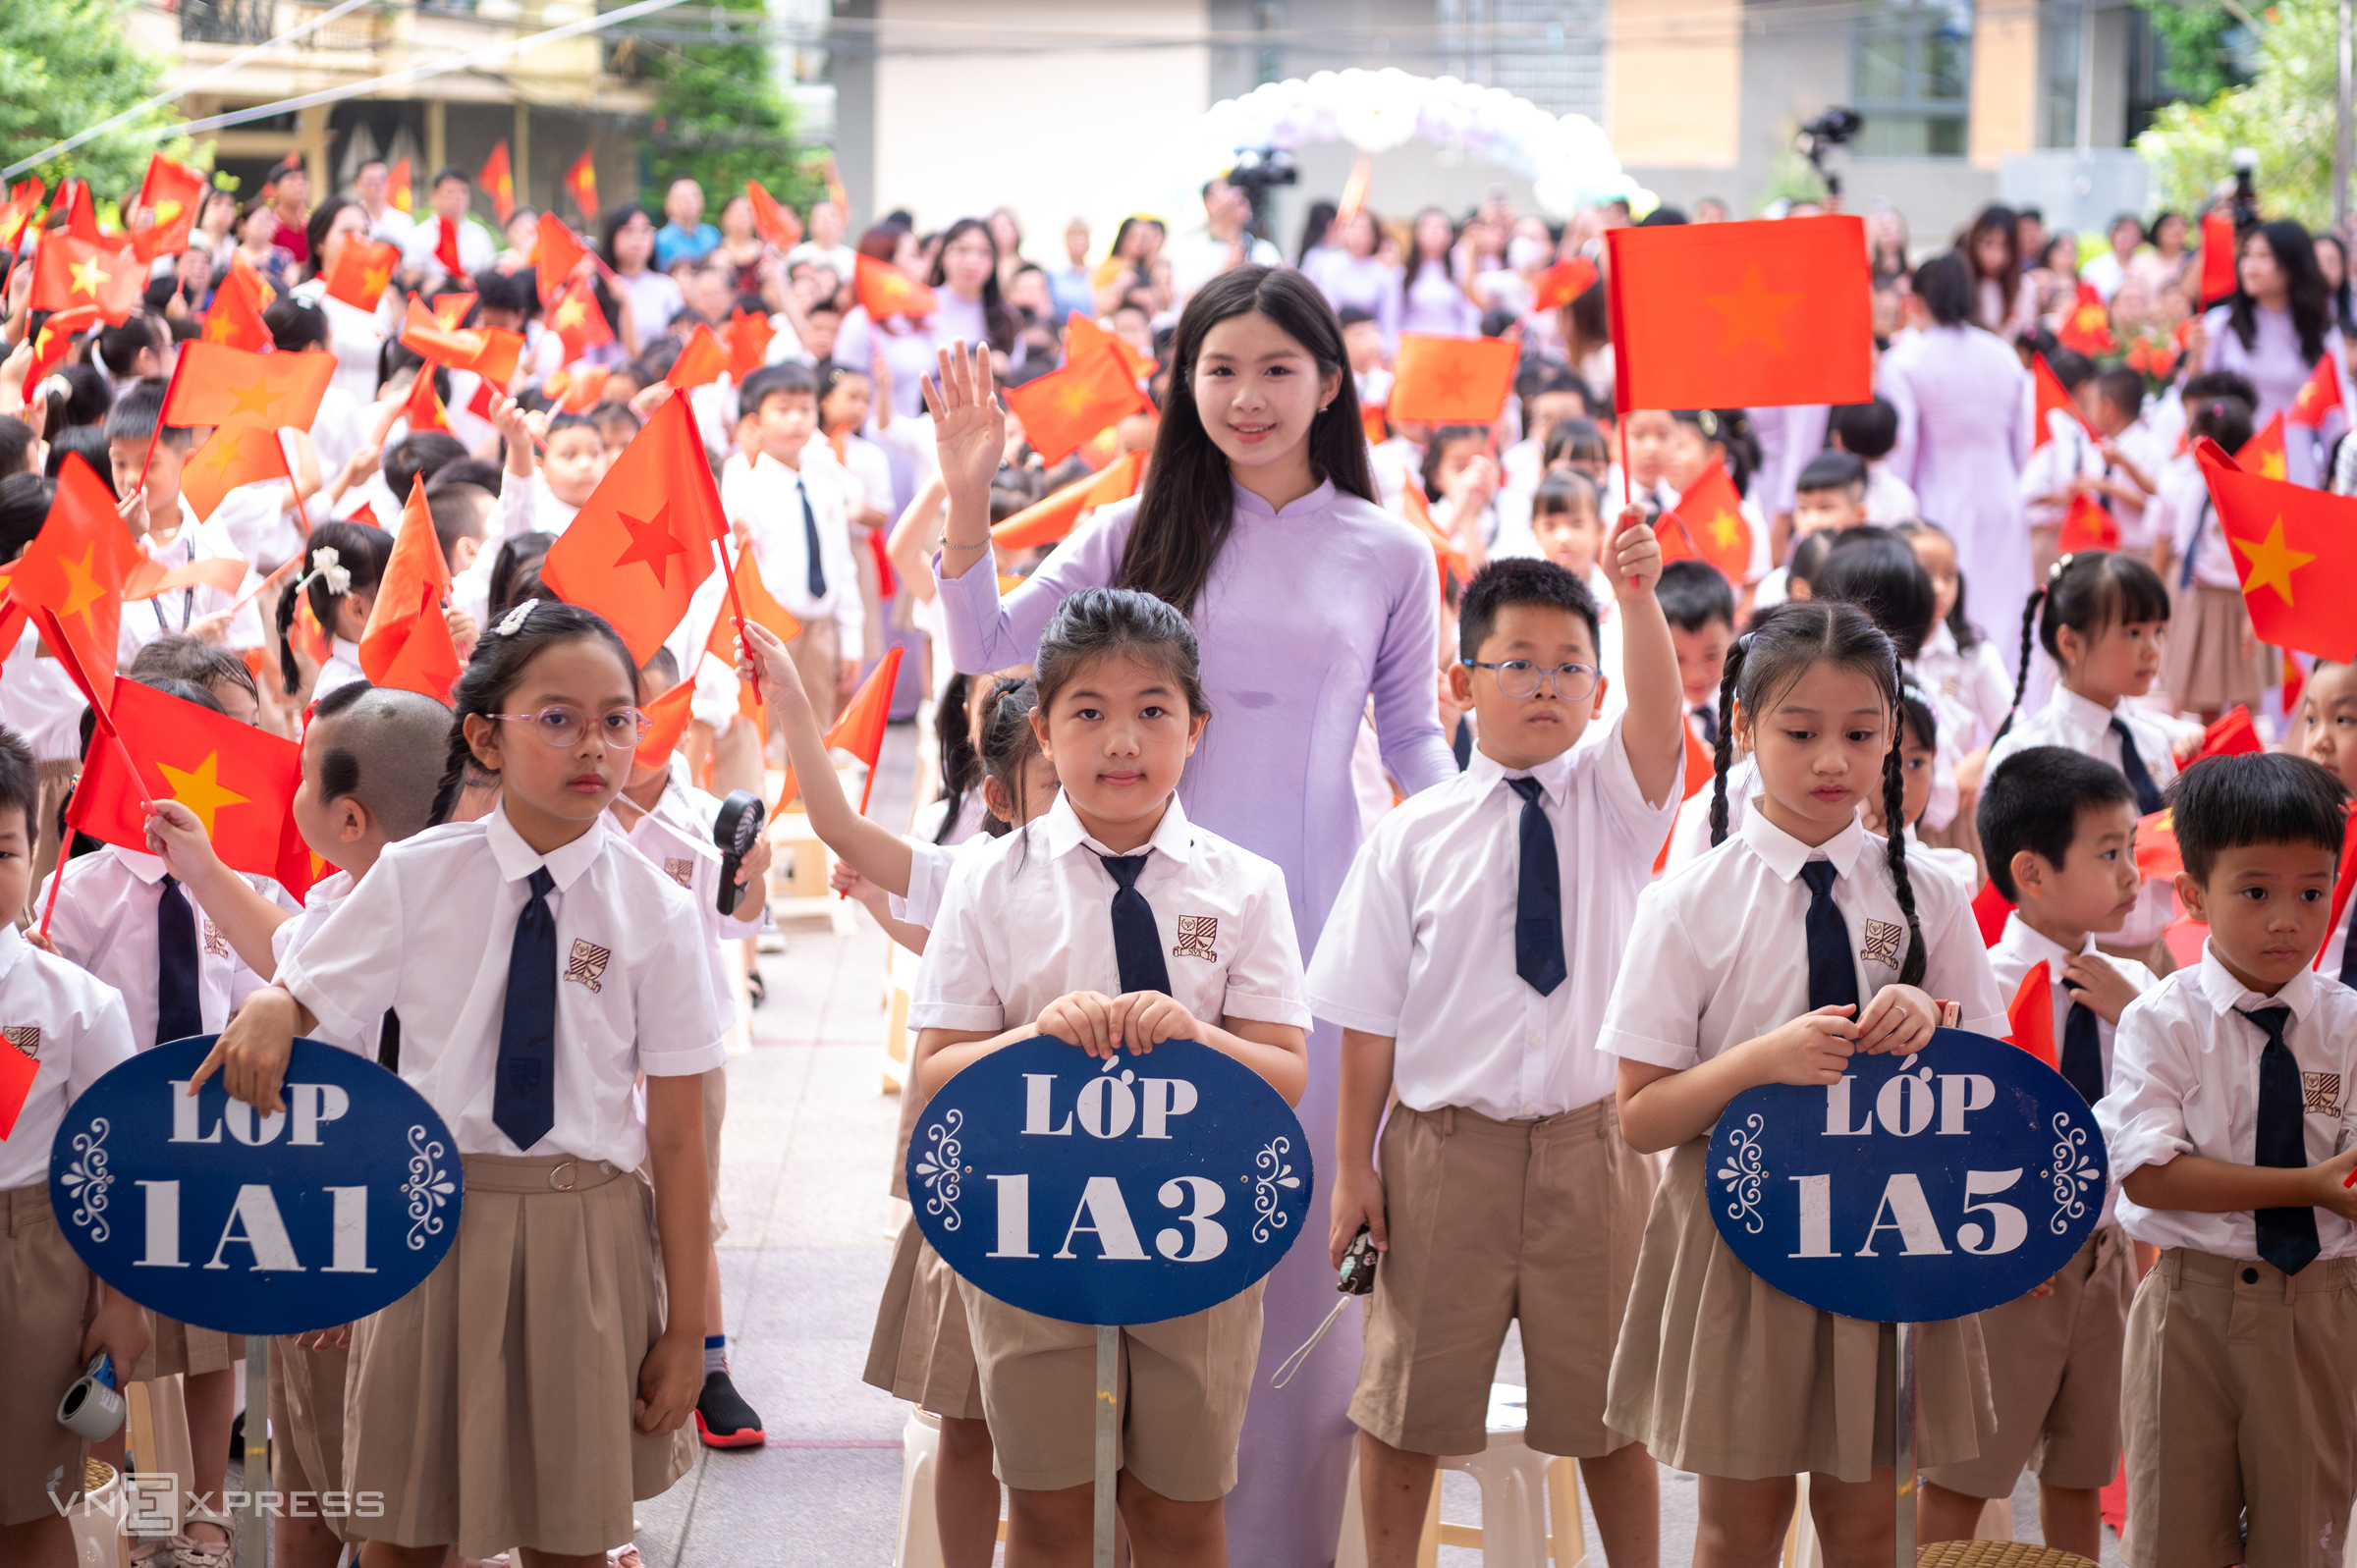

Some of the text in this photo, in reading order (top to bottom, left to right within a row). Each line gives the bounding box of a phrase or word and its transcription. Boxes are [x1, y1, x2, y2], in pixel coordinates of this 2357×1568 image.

[1020, 1054, 1199, 1139] LỚP
[1821, 1053, 1997, 1138] LỚP
[133, 1179, 379, 1273] 1A1
[985, 1173, 1229, 1263] 1A3
[1787, 1167, 2029, 1258] 1A5
